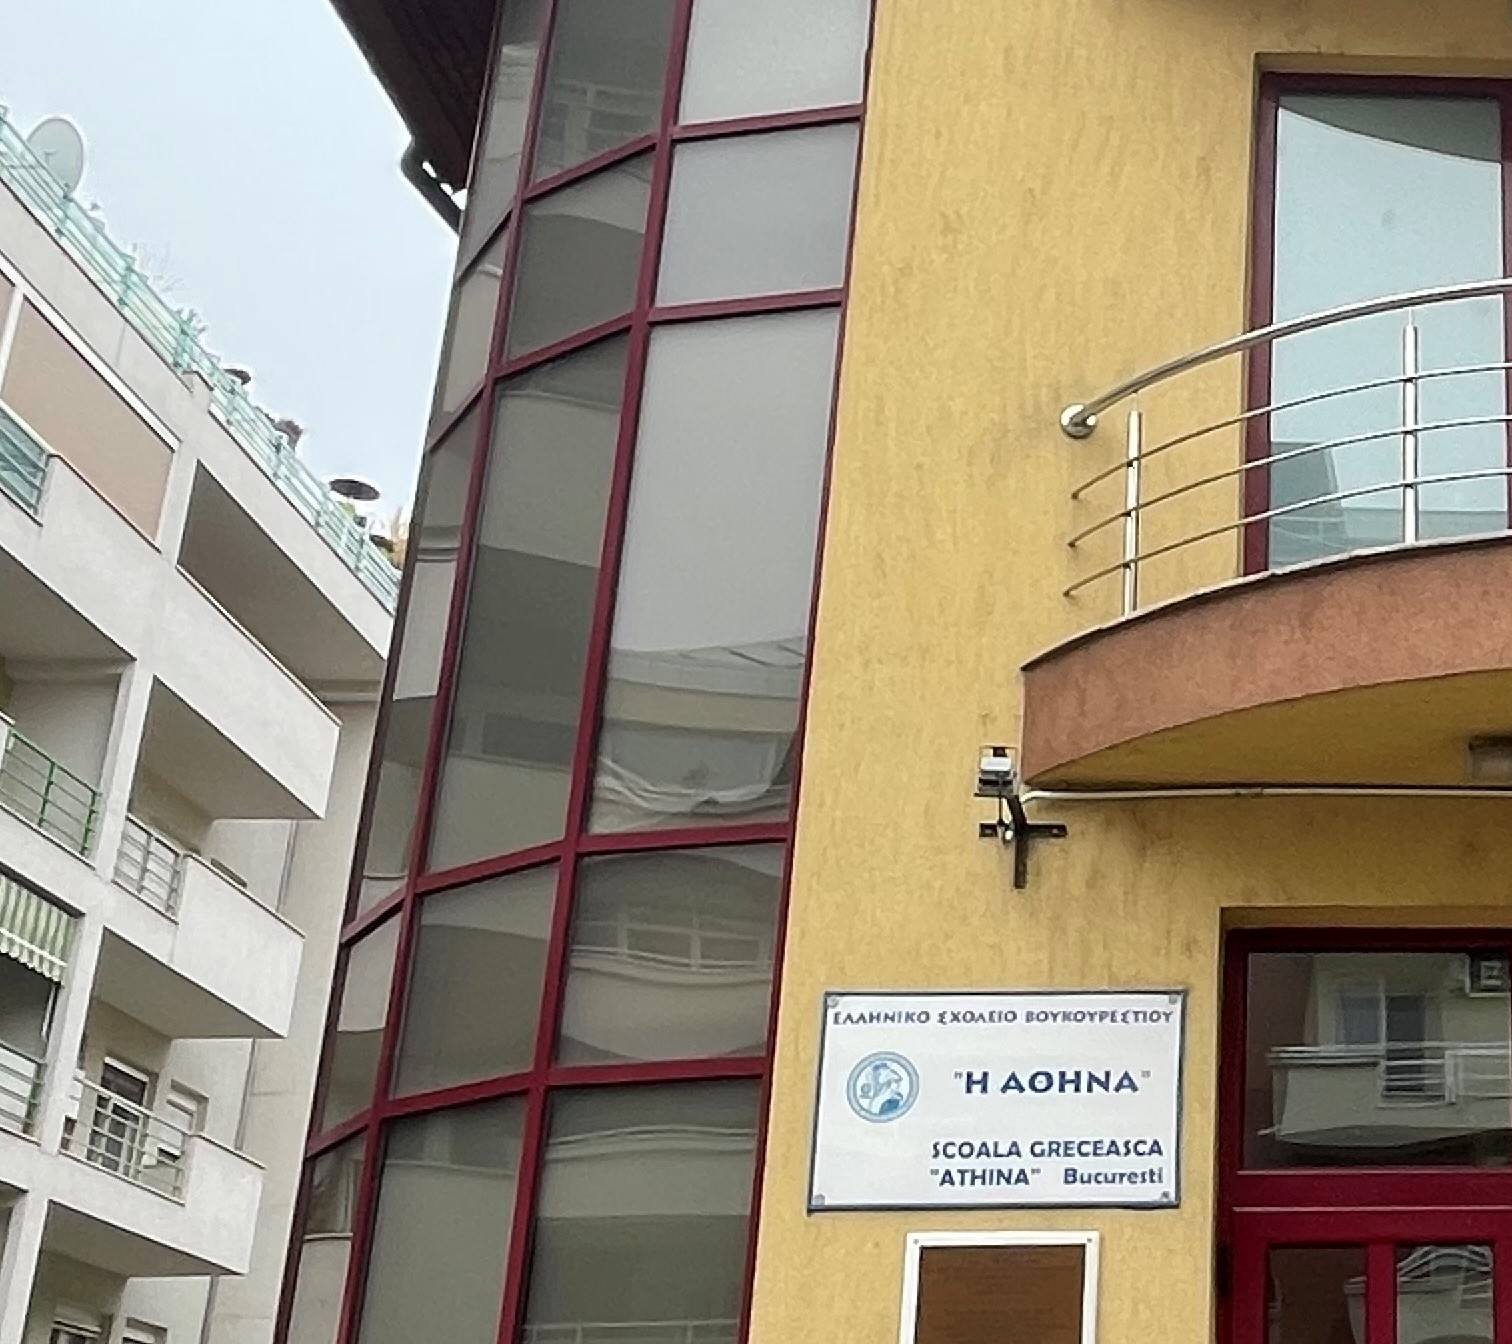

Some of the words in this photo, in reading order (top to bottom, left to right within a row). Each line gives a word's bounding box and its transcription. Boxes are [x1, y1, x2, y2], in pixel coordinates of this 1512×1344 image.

[833, 1010, 931, 1026] ΕΛΛΗΝΙΚΟ
[937, 1009, 1018, 1026] ΣΧΟΛΕΙΟ
[1025, 1009, 1174, 1025] ΒΟΥΚΟΥΡΕΣΤΙΟΥ
[932, 1140, 1022, 1159] SCOALA
[1030, 1138, 1164, 1158] GRECEASCA
[930, 1167, 1042, 1187] "ATHINA"
[1063, 1166, 1164, 1185] Bucuresti
